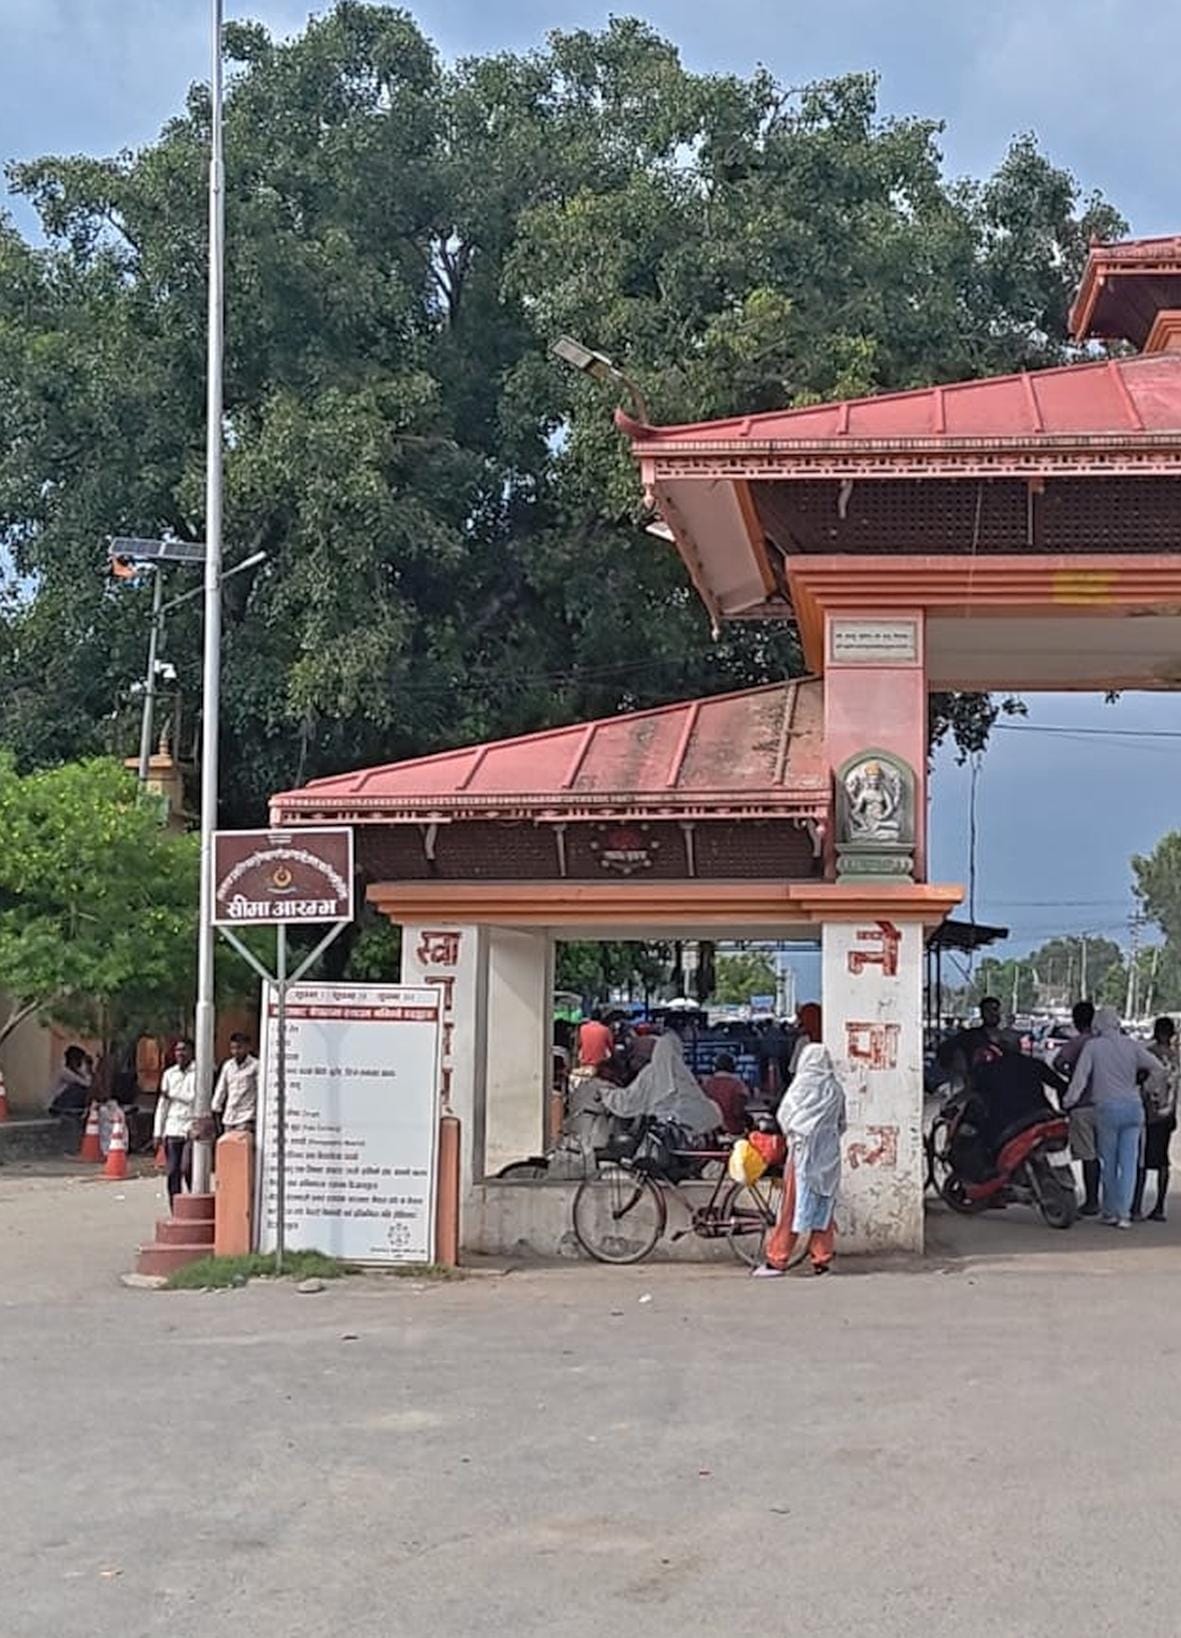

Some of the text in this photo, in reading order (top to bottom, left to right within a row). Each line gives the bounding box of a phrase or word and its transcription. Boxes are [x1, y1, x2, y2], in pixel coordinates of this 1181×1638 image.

[226, 894, 337, 918] सीमा आरम्भ
[846, 921, 902, 1169] नेपाल
